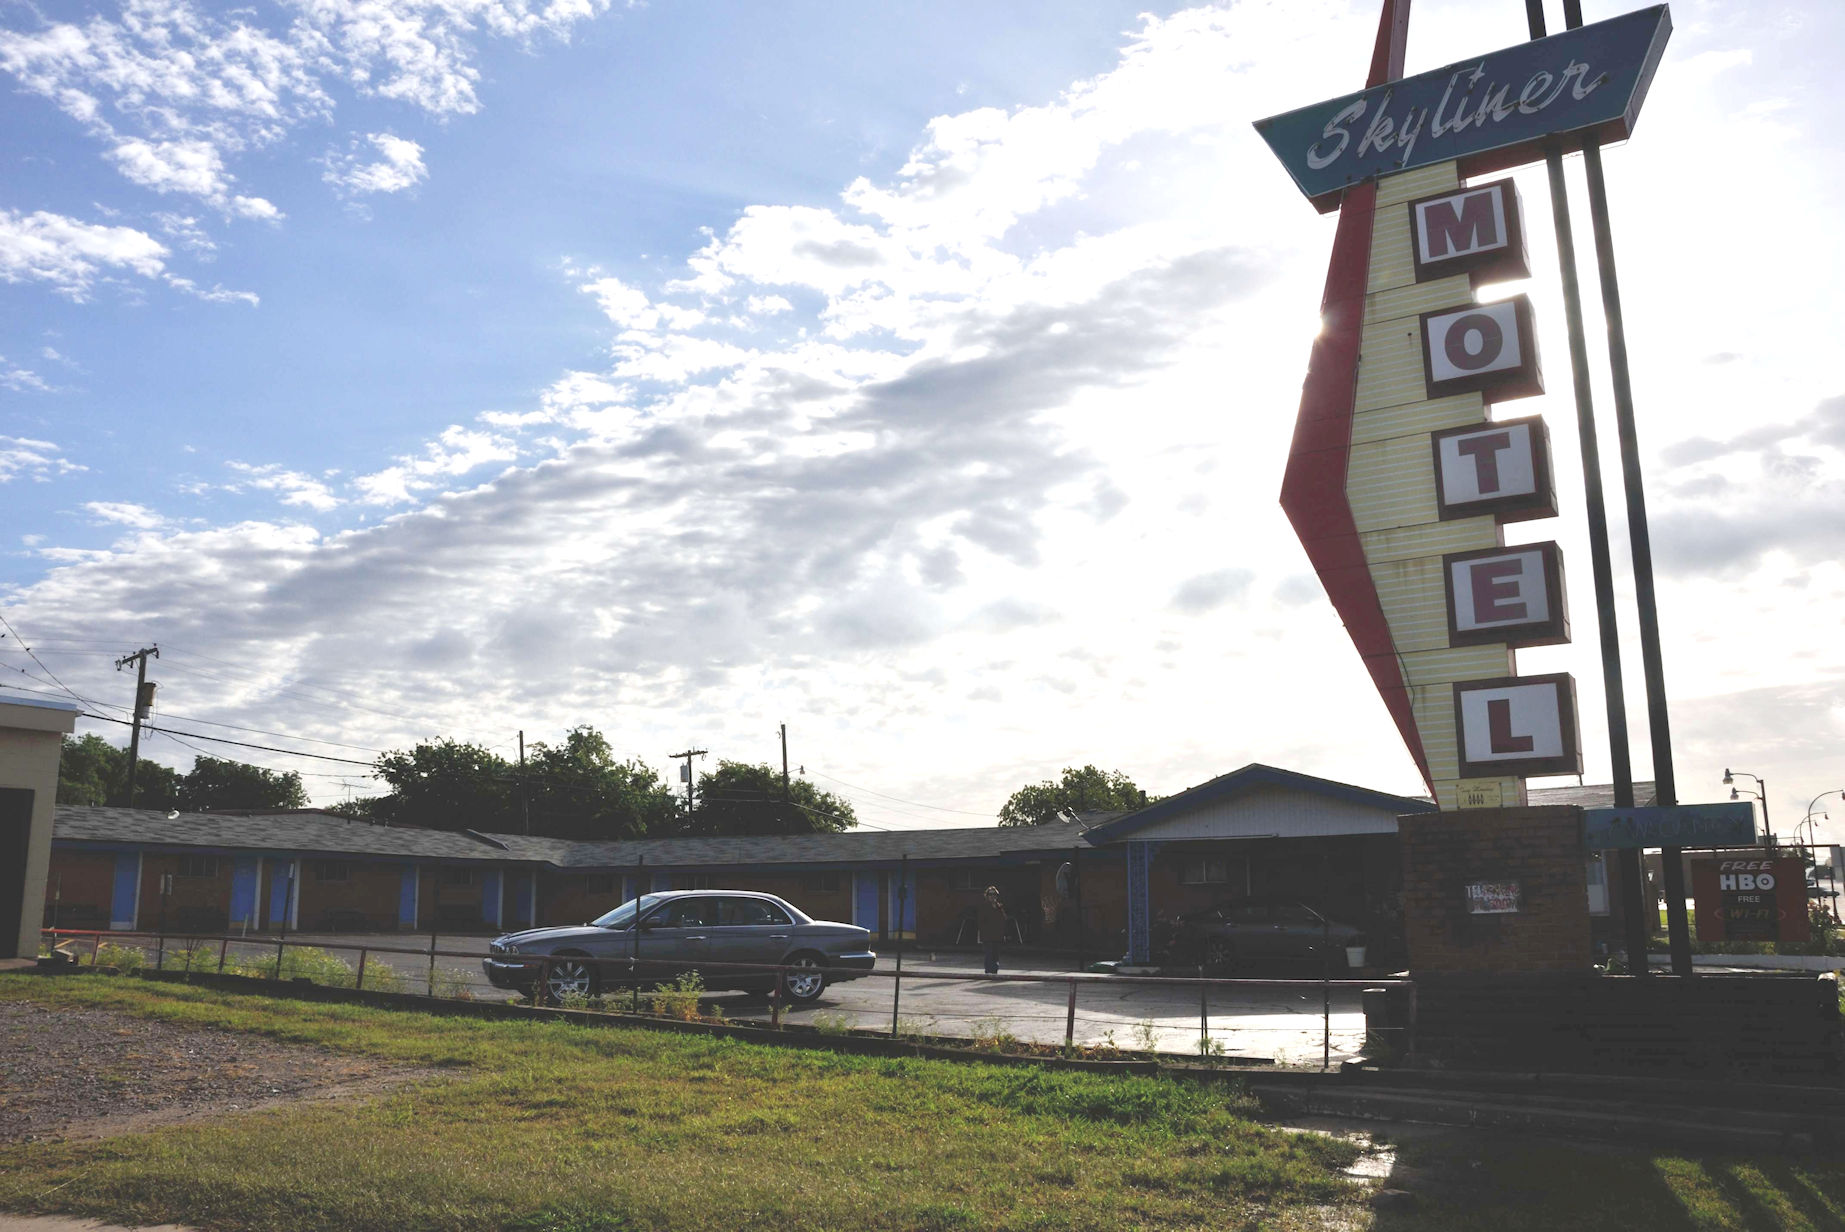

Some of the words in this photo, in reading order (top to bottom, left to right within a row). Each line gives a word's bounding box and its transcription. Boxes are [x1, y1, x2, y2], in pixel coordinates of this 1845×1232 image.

[1306, 58, 1607, 170] Skyliner
[1424, 189, 1534, 755] MOTEL
[1719, 860, 1774, 871] FREE
[1719, 873, 1776, 891] HBO
[1737, 895, 1761, 904] FREE
